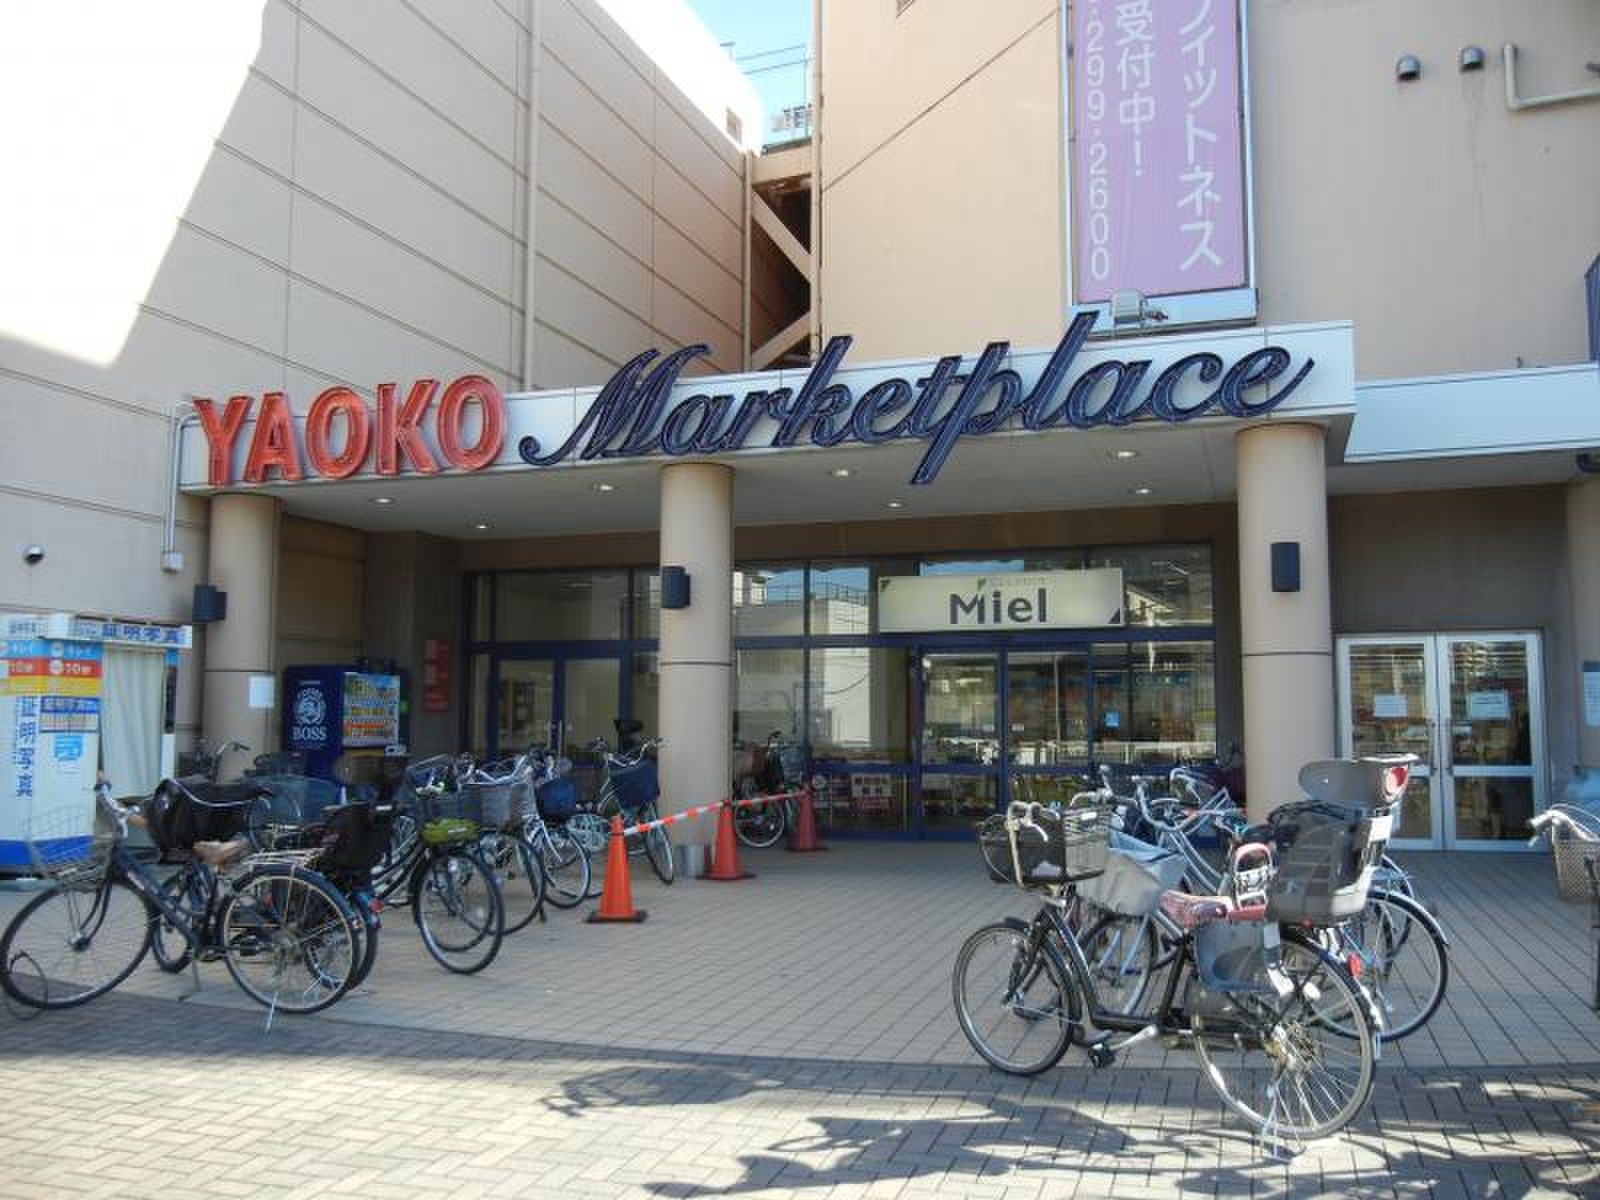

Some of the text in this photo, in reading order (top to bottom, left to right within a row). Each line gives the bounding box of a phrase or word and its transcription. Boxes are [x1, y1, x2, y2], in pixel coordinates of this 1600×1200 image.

[193, 311, 1314, 488] YAOKO Marketplace
[949, 587, 1047, 625] Miel
[292, 725, 328, 741] BOSS
